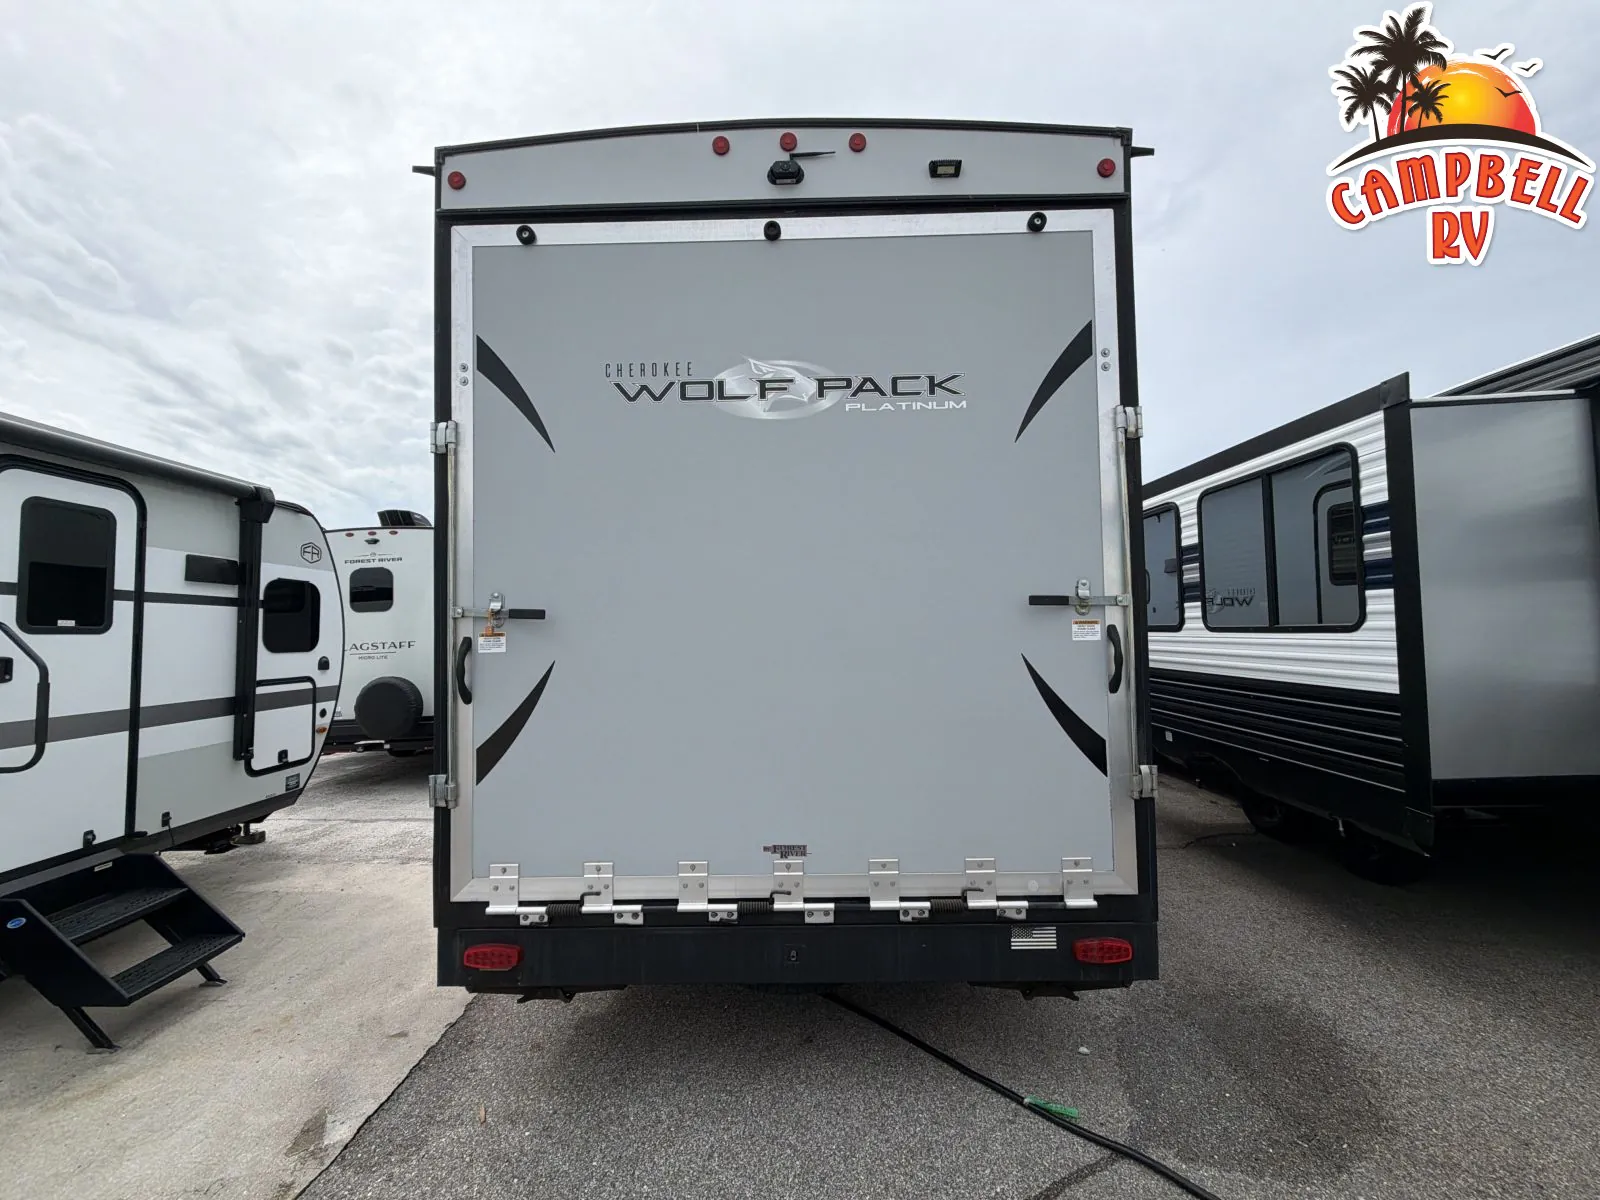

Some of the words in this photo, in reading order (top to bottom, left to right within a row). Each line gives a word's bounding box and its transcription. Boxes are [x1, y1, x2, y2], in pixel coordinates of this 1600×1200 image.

[605, 362, 692, 378] CHEROKEE
[610, 378, 796, 403] WOLF
[811, 373, 966, 400] PACK
[845, 401, 967, 411] PLATINUM
[344, 640, 417, 651] AGSTAFF
